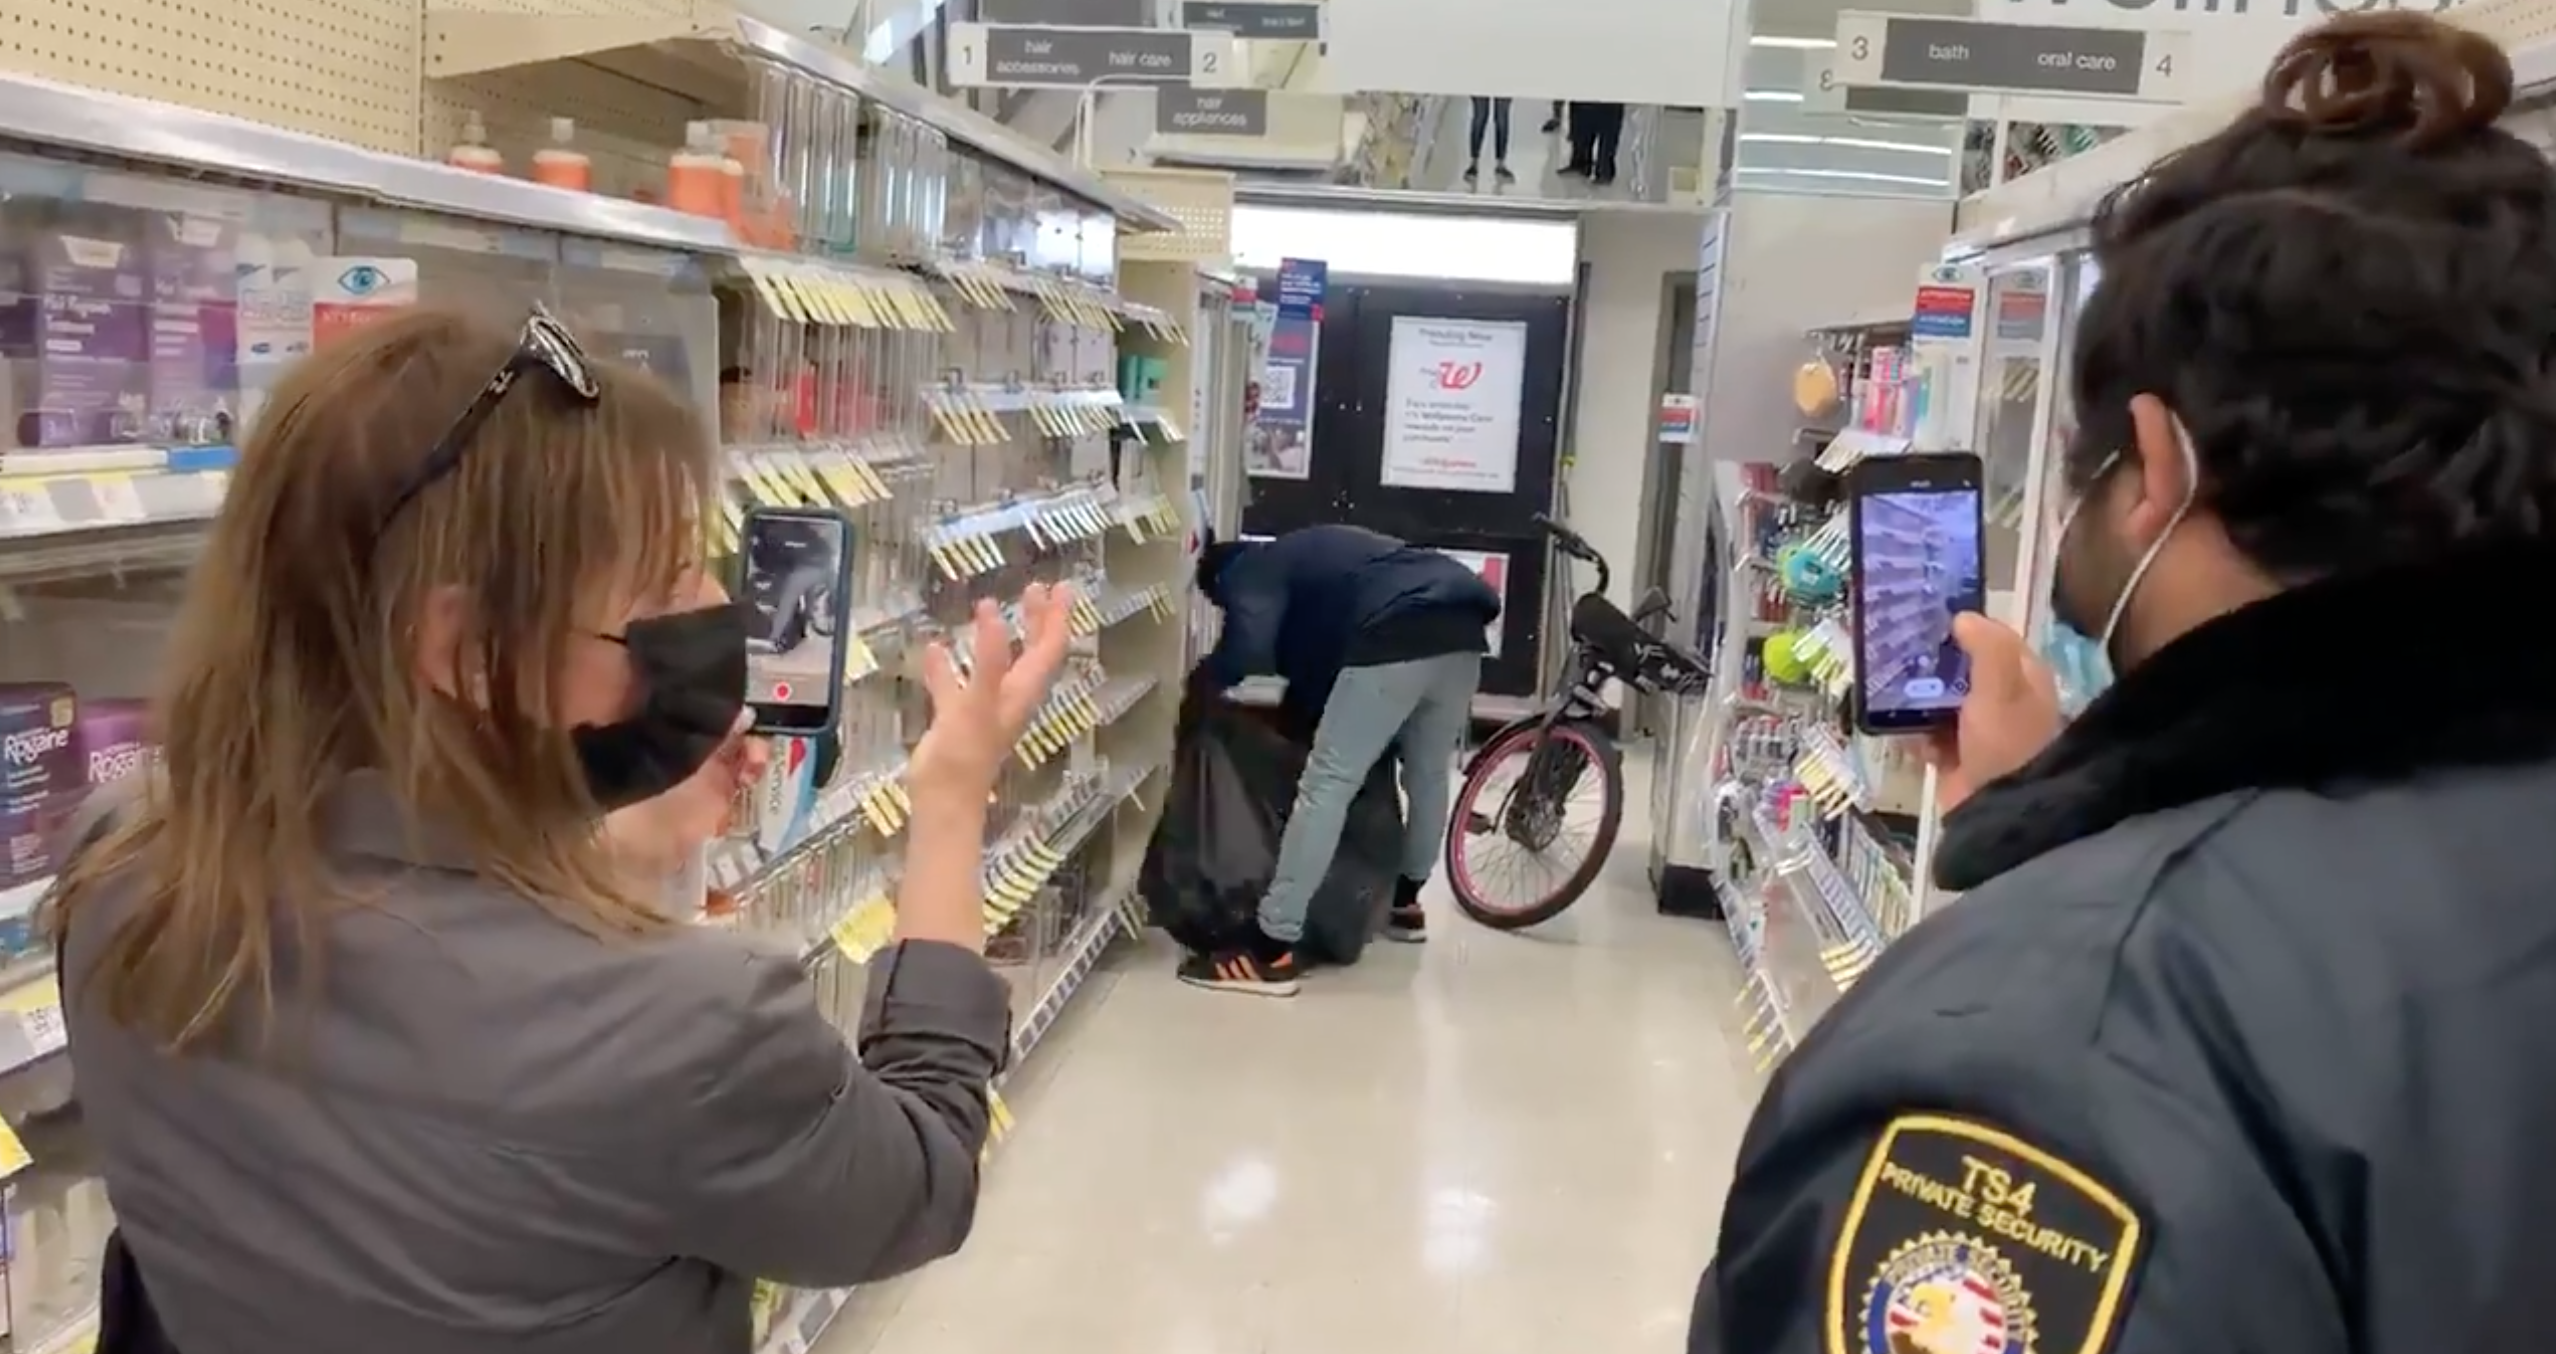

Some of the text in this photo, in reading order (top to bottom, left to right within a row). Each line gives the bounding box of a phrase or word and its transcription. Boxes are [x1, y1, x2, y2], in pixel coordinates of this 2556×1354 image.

[963, 45, 971, 65] 1
[1024, 39, 1053, 53] hair
[1851, 35, 1869, 61] 3
[1928, 43, 1970, 60] bath
[996, 60, 1080, 75] accessories
[1109, 51, 1172, 67] hair care
[1203, 52, 1217, 73] 2
[2037, 51, 2117, 71] oral care
[2156, 53, 2172, 77] 4
[1197, 97, 1223, 110] hair
[1173, 111, 1248, 127] appliances
[1960, 1154, 2037, 1216] TS4
[1880, 1161, 1975, 1219] PRIVATE
[1976, 1201, 2110, 1273] SECURITY
